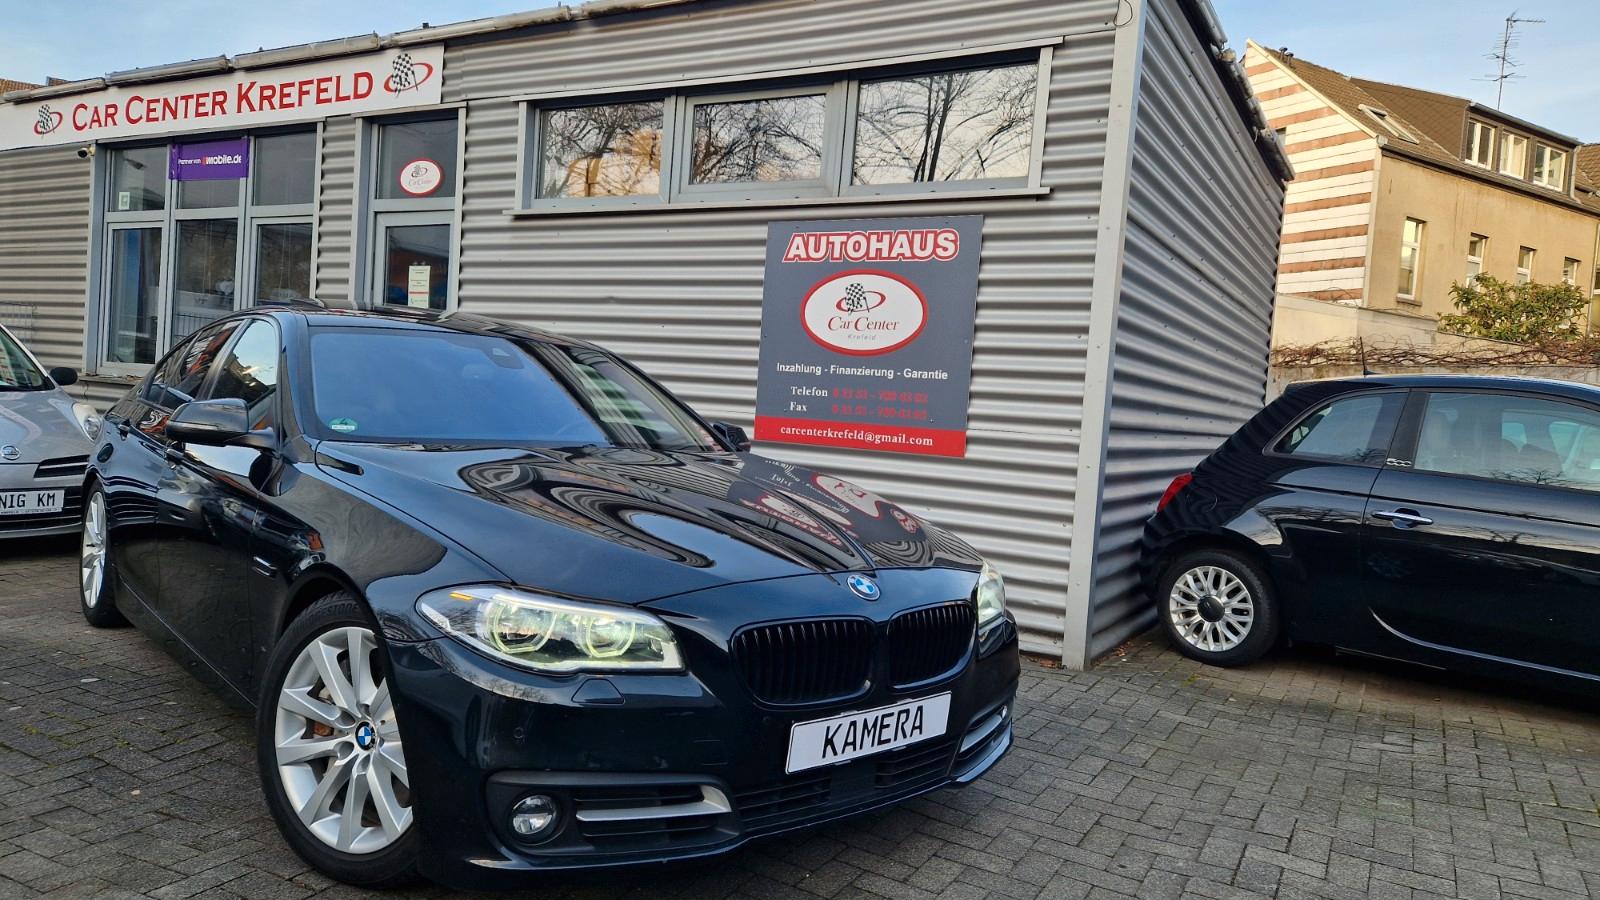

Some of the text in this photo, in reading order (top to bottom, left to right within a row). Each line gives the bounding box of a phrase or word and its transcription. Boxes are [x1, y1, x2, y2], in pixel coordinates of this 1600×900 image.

[72, 71, 374, 131] CAR CENTER KREFELD
[783, 229, 960, 262] AUTOHAUS
[828, 316, 900, 331] Car Center
[776, 362, 822, 375] Inzahlung
[830, 365, 894, 379] Finanzierung
[903, 368, 948, 380] Garantie
[790, 386, 828, 397] Telefon
[789, 401, 807, 412] Fax
[780, 425, 934, 446] carcenterkrefeld@gmail.com
[37, 492, 56, 507] KM
[822, 705, 924, 758] KAMERA
